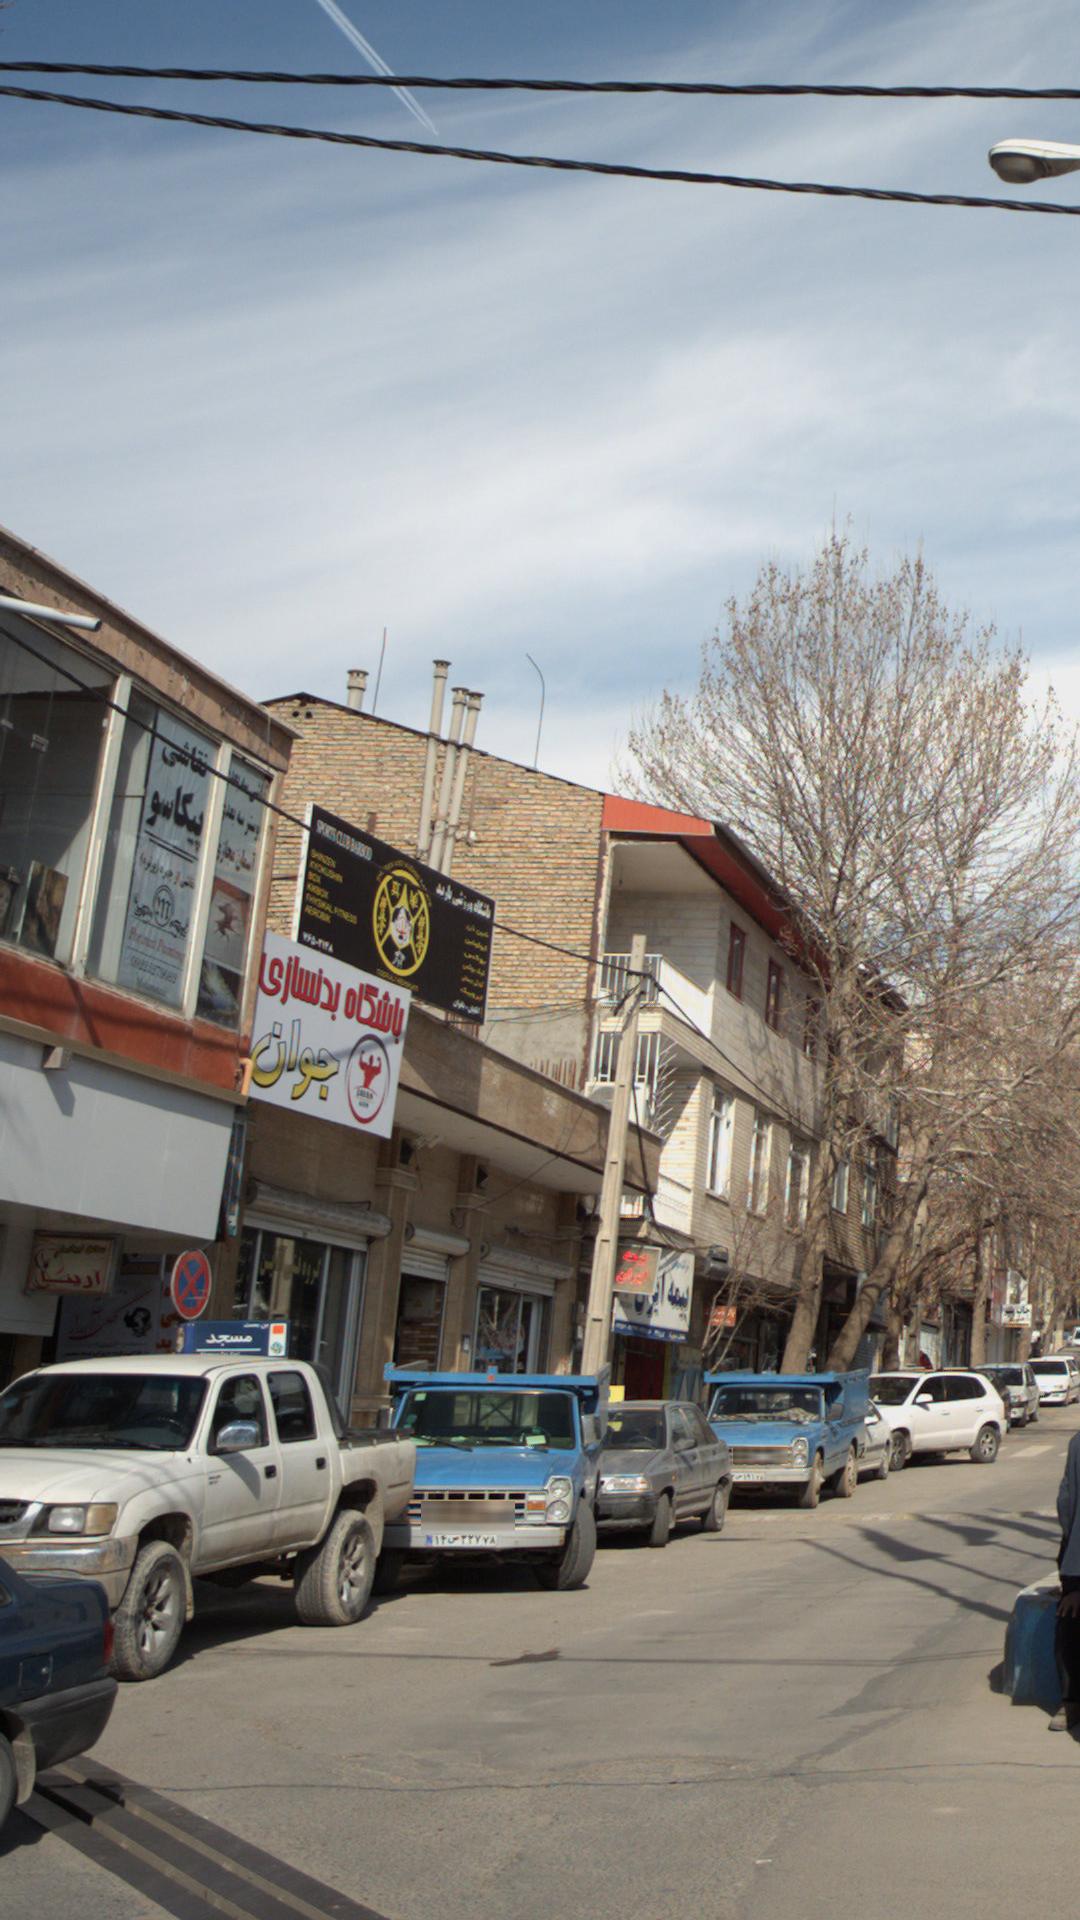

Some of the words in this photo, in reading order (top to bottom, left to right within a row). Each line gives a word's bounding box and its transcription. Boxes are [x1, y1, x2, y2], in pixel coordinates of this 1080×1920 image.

[258, 952, 341, 1021] بدنسازی
[344, 982, 405, 1044] باشگاه
[250, 1018, 341, 1101] جوان
[205, 1333, 253, 1347] مسجد
